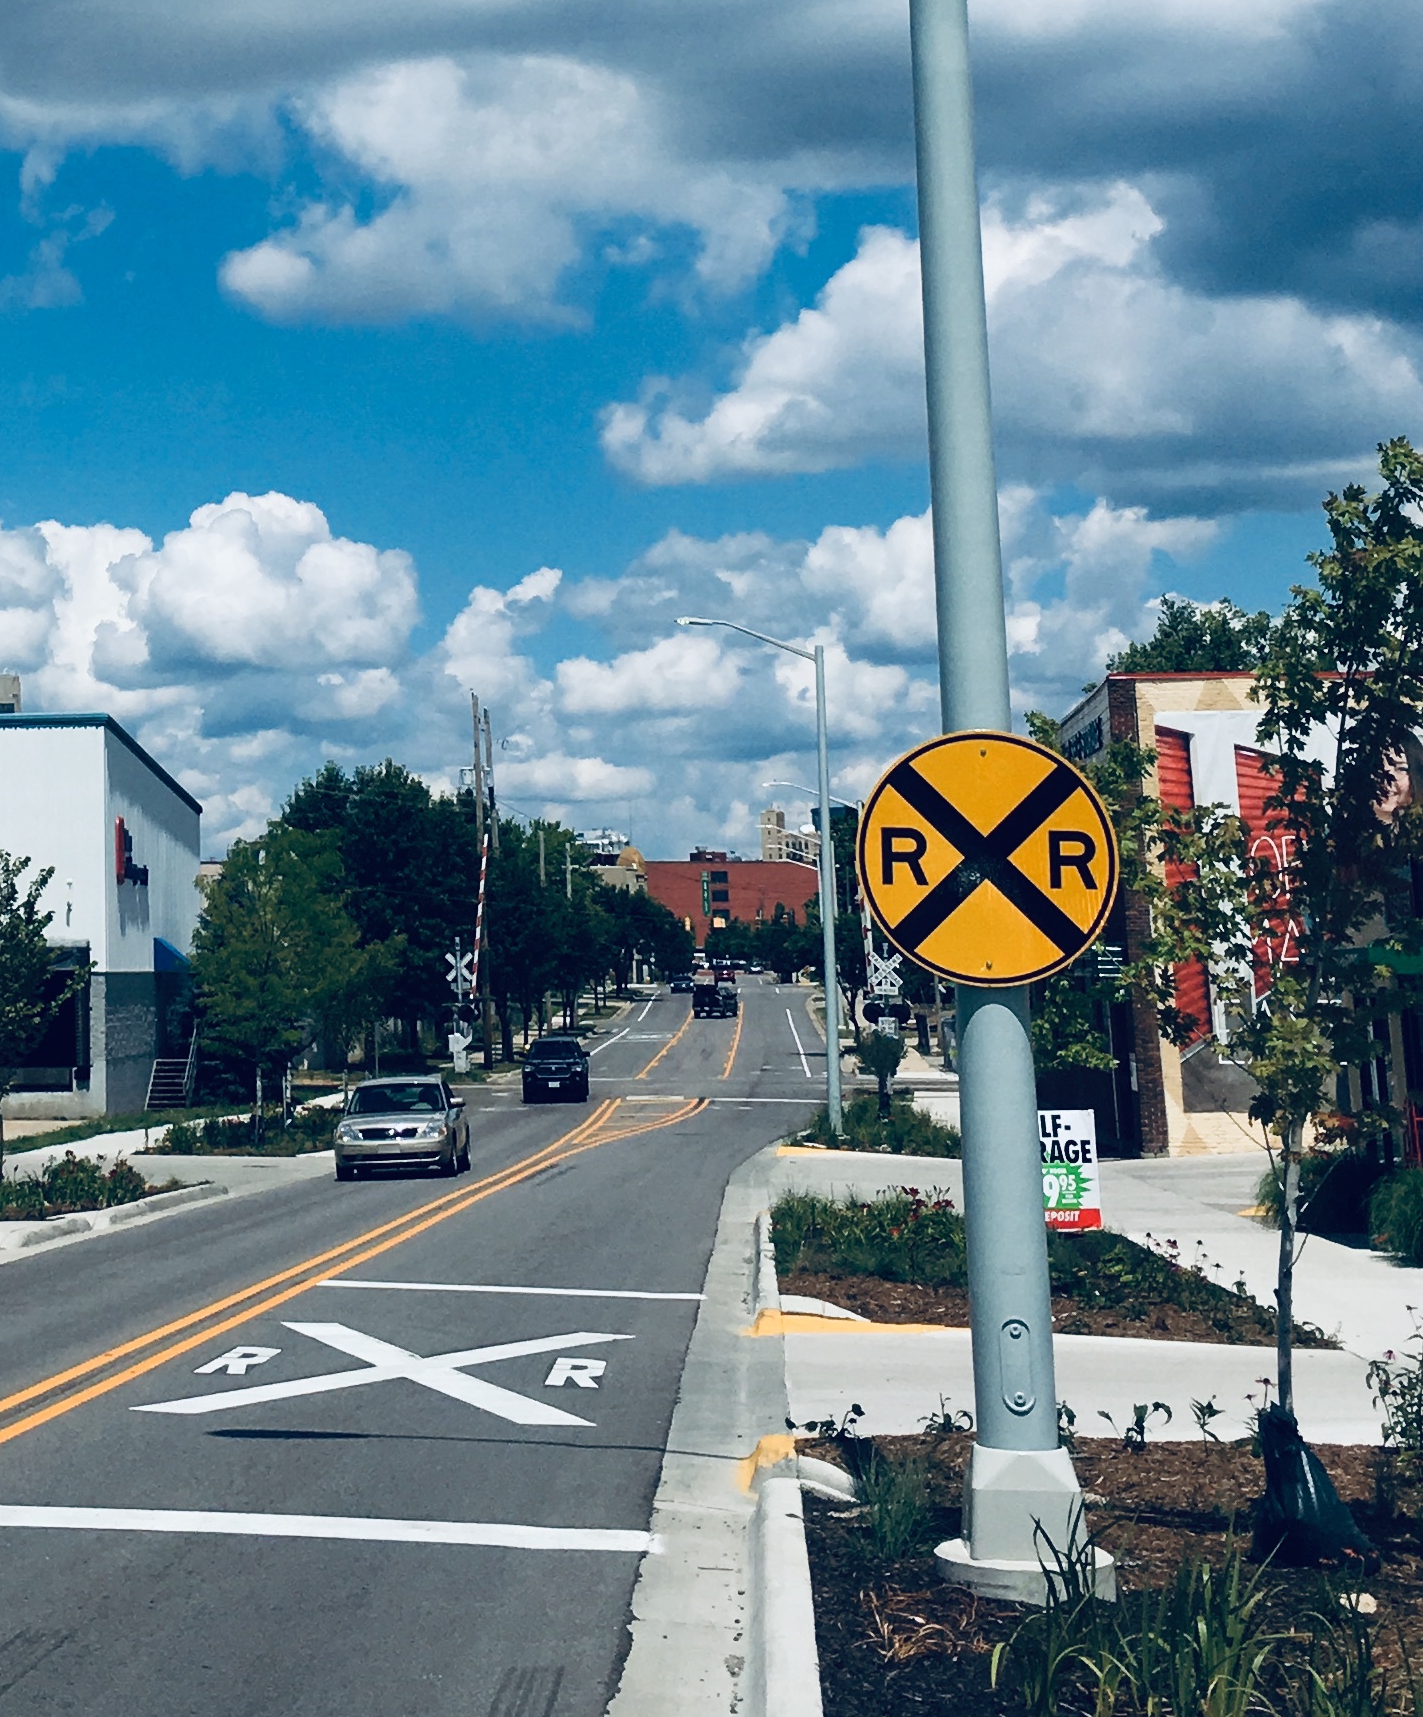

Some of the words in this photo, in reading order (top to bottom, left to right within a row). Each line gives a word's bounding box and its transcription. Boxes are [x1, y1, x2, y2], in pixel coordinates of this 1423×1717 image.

[881, 826, 929, 886] R
[1048, 830, 1098, 890] R
[1040, 1114, 1071, 1138] LF-
[1040, 1139, 1093, 1164] RAGE
[1042, 1174, 1060, 1208] 9
[1044, 1210, 1080, 1223] EPOSIT
[194, 1346, 281, 1375] R
[544, 1357, 607, 1389] R
